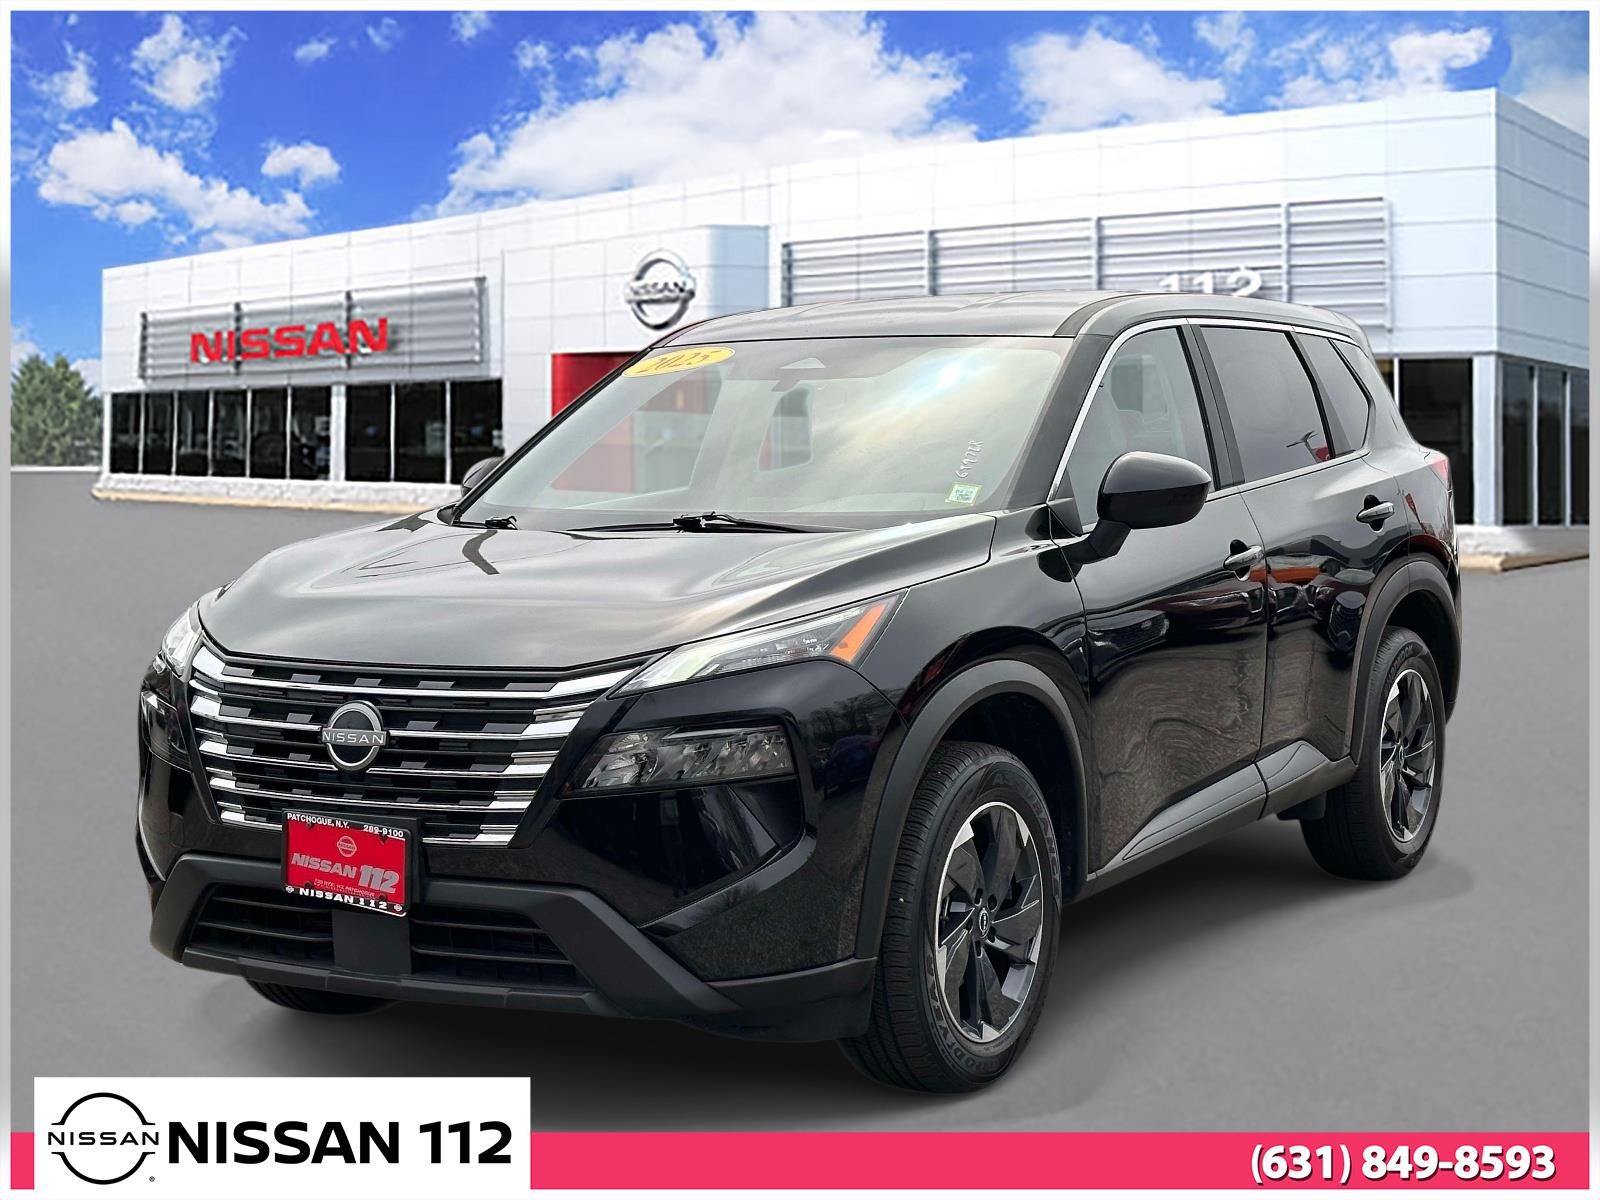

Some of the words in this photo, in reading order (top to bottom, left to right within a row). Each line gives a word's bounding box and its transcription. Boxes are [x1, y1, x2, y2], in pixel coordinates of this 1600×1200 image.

[629, 281, 688, 297] NISSAN
[189, 317, 389, 363] NISSAN
[322, 731, 384, 744] NISSAN
[363, 824, 404, 838] 289-9100
[291, 853, 357, 879] NISSAN
[358, 864, 400, 894] 112
[299, 887, 354, 904] NISSAN
[359, 897, 388, 910] 112
